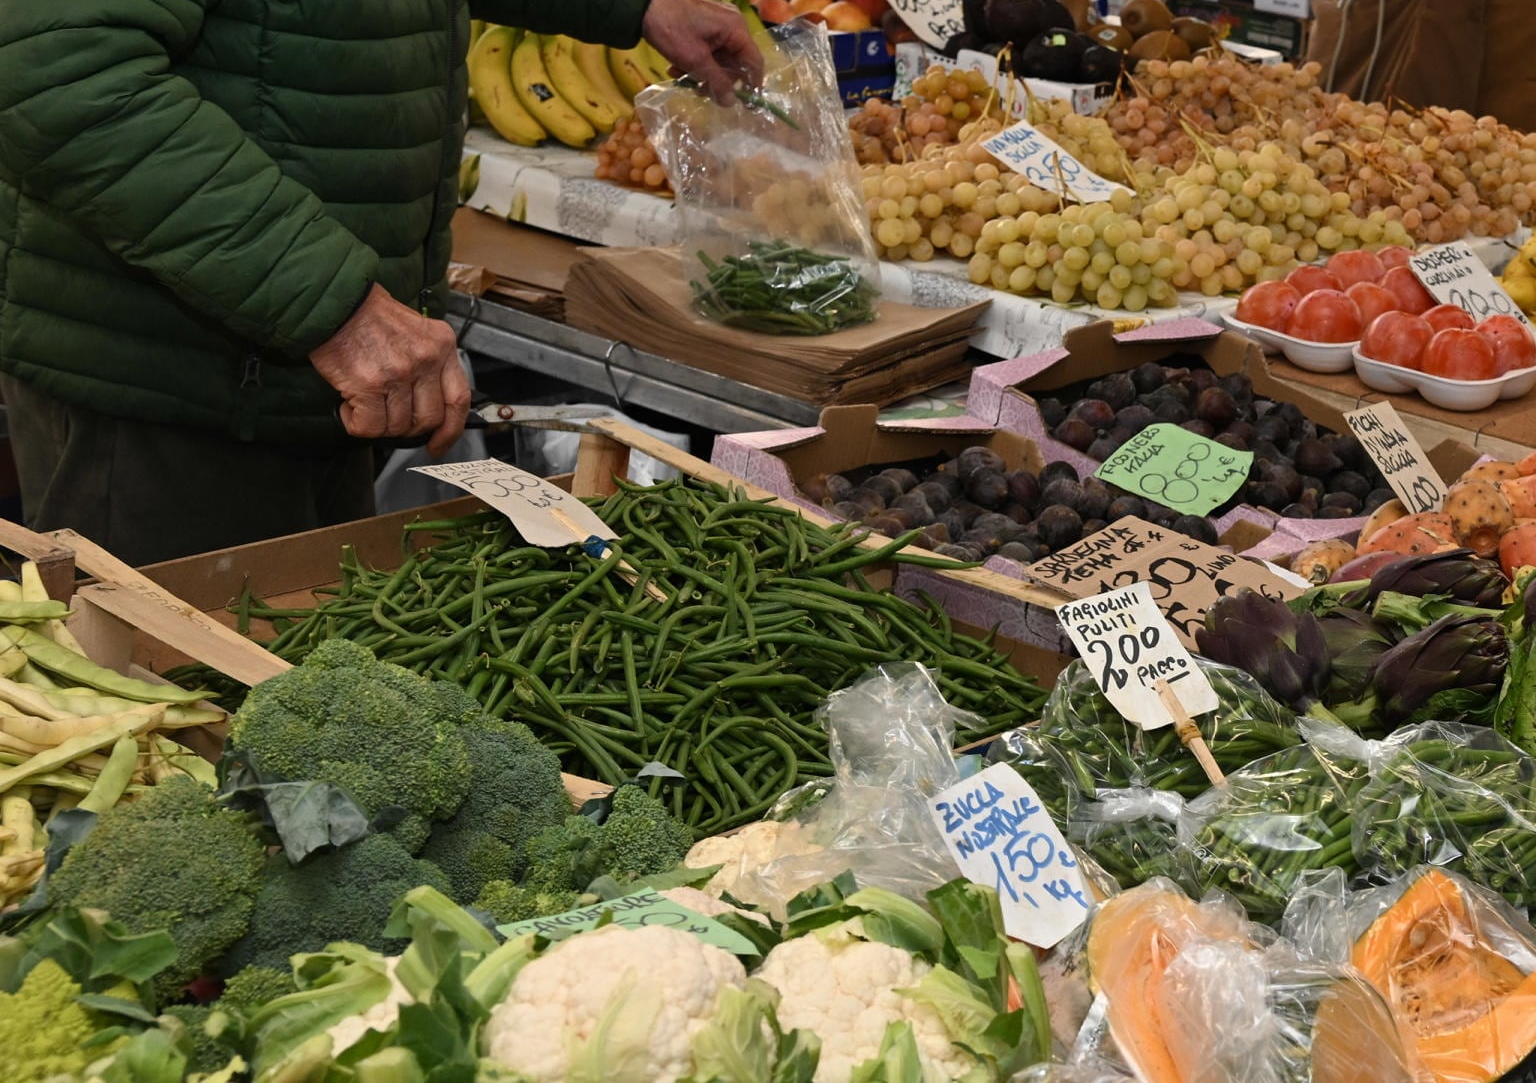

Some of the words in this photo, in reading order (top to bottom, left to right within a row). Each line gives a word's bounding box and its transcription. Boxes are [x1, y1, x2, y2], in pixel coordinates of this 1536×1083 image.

[460, 474, 541, 498] 500
[1062, 553, 1123, 584] TEMA
[1059, 592, 1140, 627] FAGIOLINI
[1077, 613, 1137, 642] PULITI
[1137, 656, 1187, 687] PACCO
